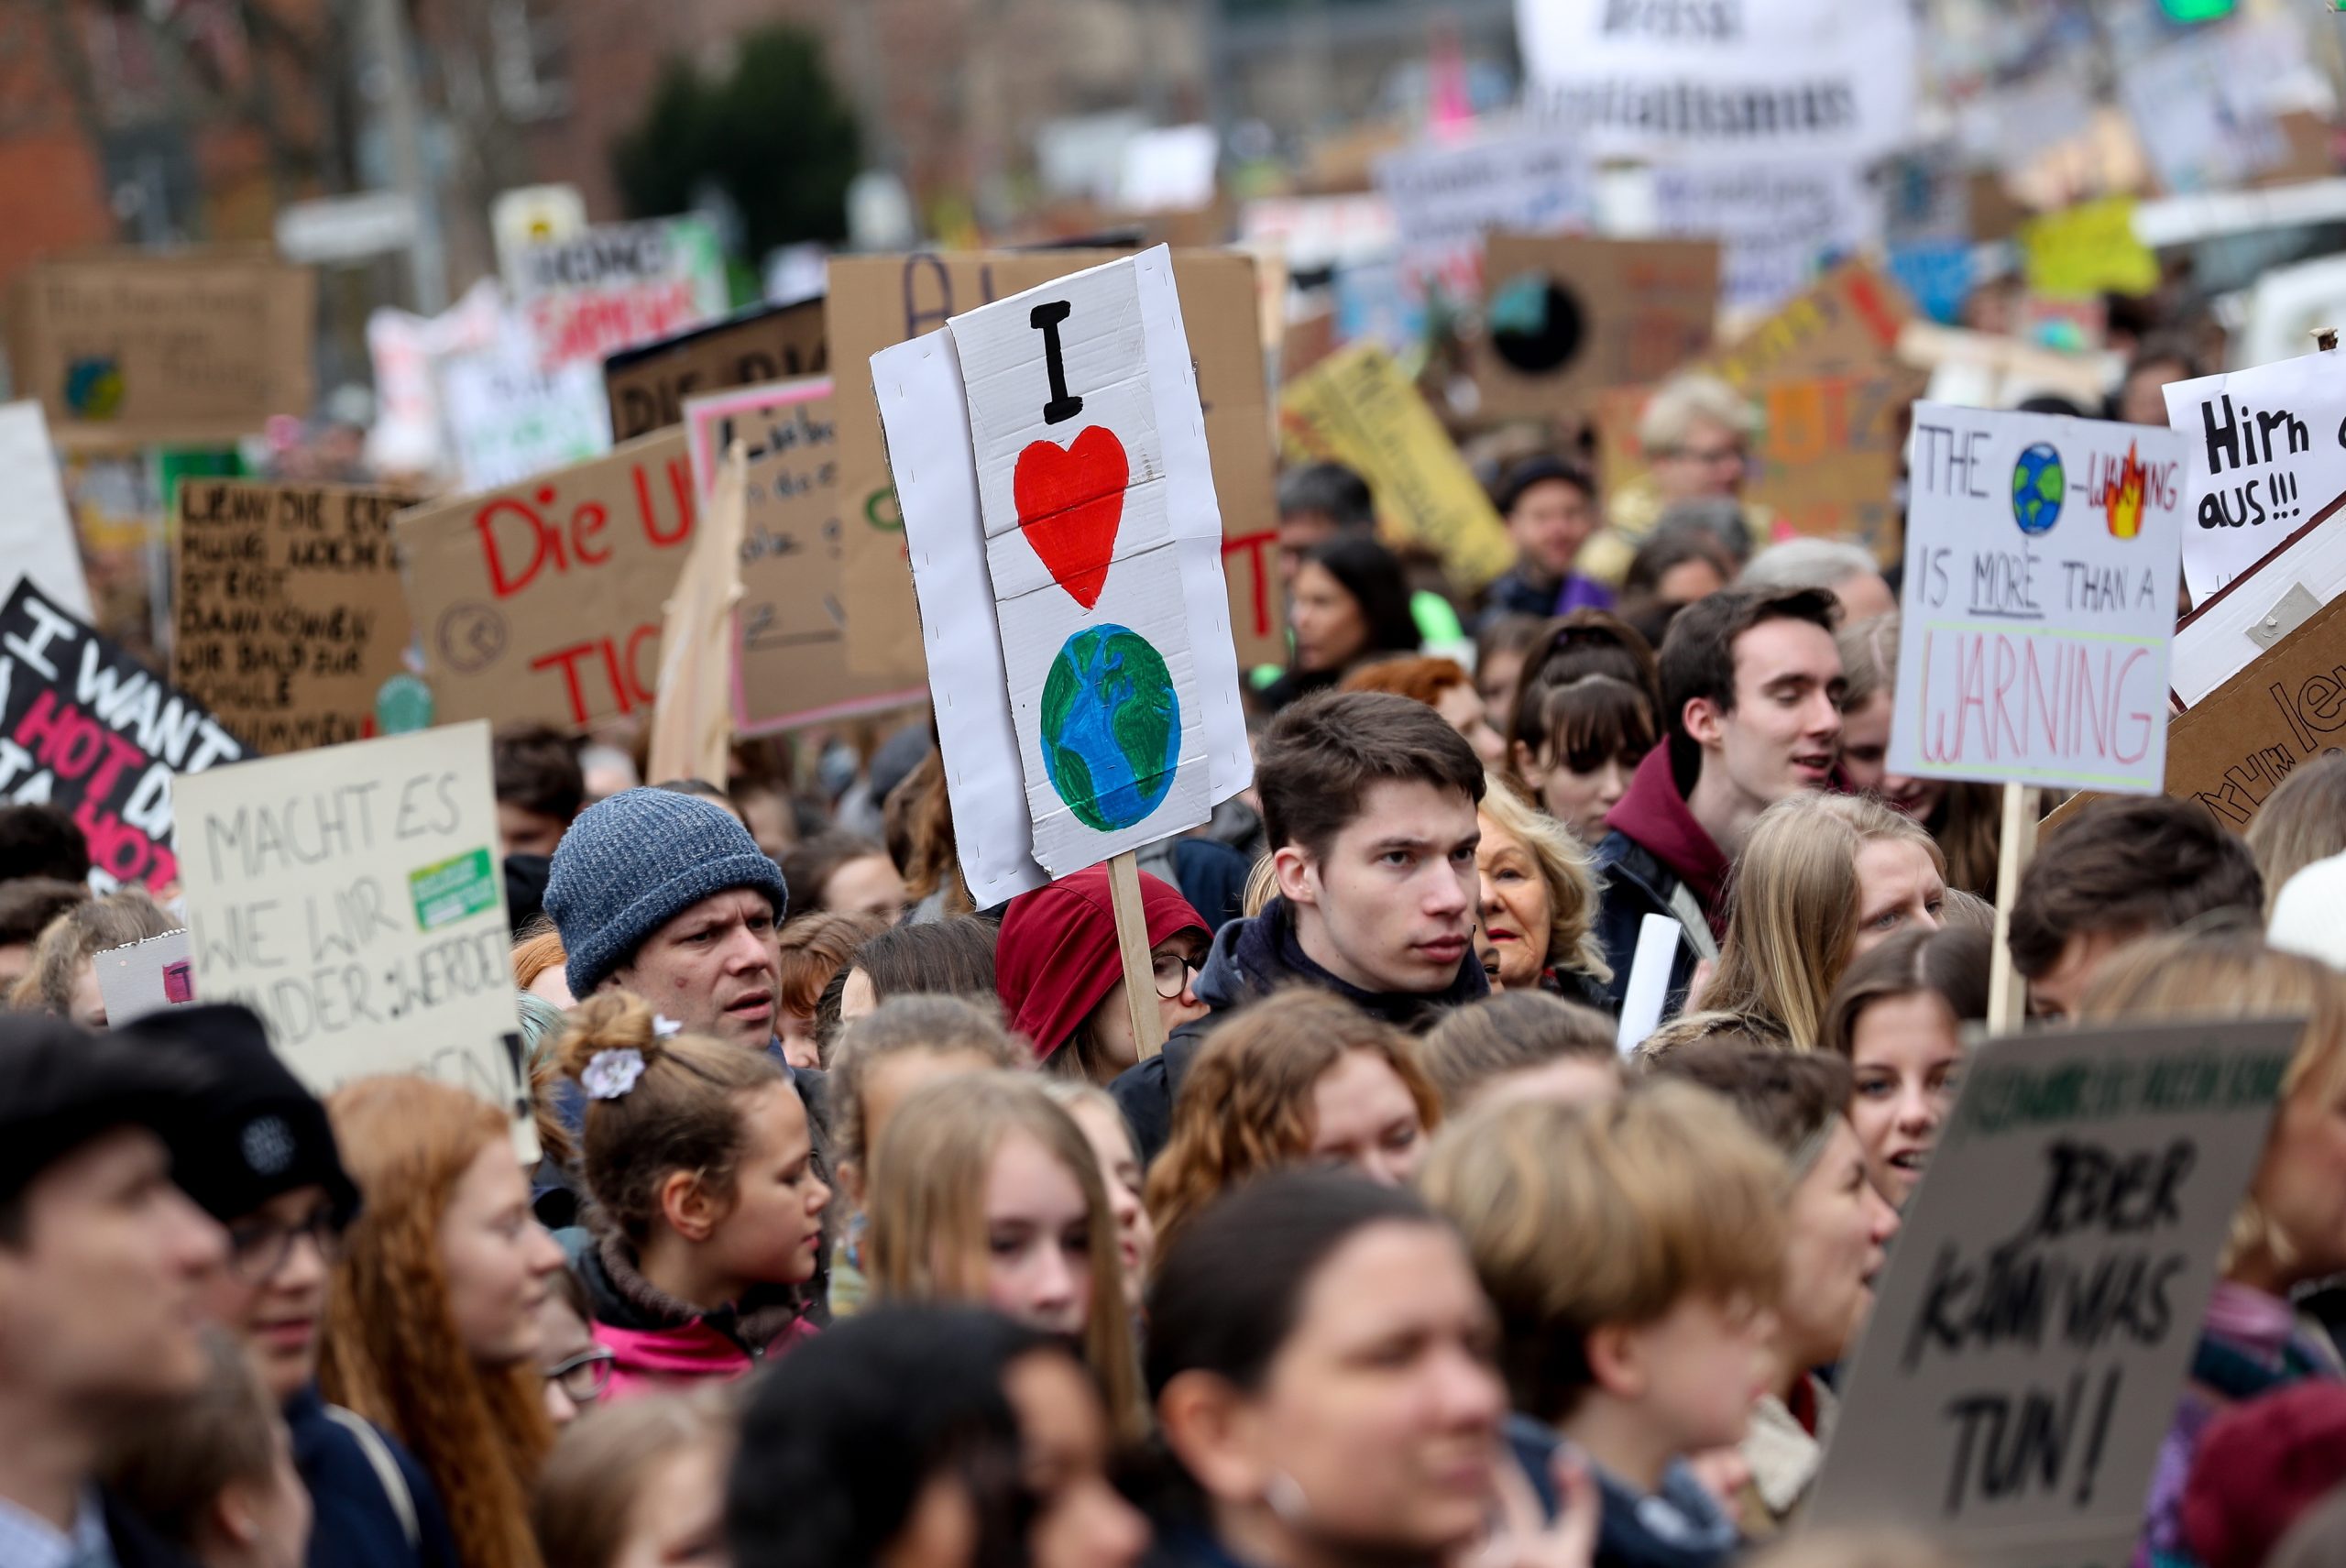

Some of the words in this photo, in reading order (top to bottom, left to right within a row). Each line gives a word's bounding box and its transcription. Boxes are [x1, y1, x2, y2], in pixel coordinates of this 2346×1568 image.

[1030, 300, 1083, 425] I
[1917, 422, 1992, 499] THE
[2201, 393, 2309, 475] Hirn
[278, 488, 324, 532] DIE
[474, 484, 613, 600] Die
[632, 454, 696, 548] U
[2198, 471, 2301, 529] aus!!!
[1917, 546, 1951, 609] IS
[1972, 551, 2043, 611] MORE
[2061, 560, 2130, 611] THAN
[2133, 566, 2156, 611] A
[5, 596, 78, 681] I
[76, 638, 242, 774] WANT
[236, 638, 307, 676] BALD
[1921, 630, 2154, 766] WARNING
[14, 688, 148, 805] HOT
[123, 761, 179, 854] D
[205, 779, 381, 883] MACHT
[396, 772, 462, 840] ES
[305, 874, 403, 964] WIR
[2020, 1135, 2198, 1241] JEDER
[2062, 1246, 2190, 1350] WAS
[1945, 1365, 2124, 1518] TUN!
